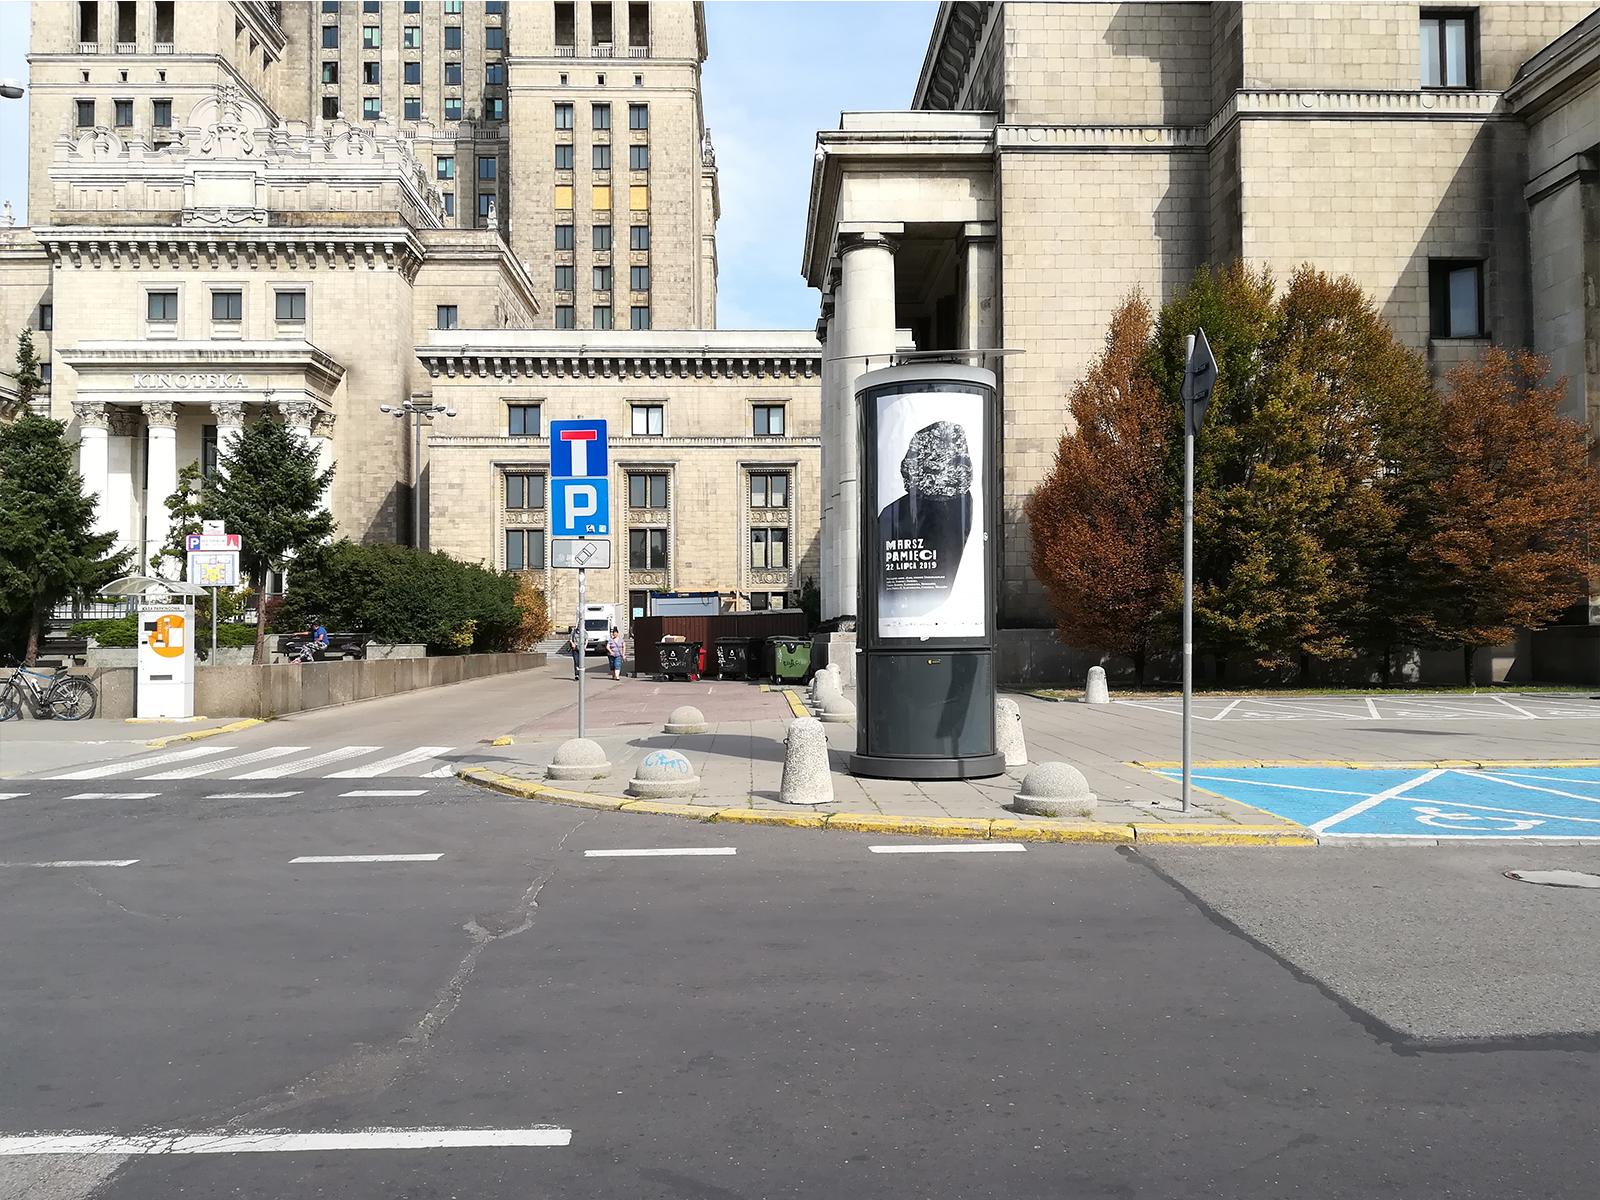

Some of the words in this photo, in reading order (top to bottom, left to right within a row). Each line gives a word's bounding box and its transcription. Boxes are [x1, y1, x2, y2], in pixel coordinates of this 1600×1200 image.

[132, 374, 248, 388] KINOTEKA
[564, 484, 597, 529] P
[190, 537, 200, 550] P
[885, 538, 924, 551] MARSZ
[885, 549, 937, 562] PAMIĘCI
[885, 563, 894, 571] 22
[896, 562, 917, 570] LIPCA
[919, 561, 937, 569] 2019
